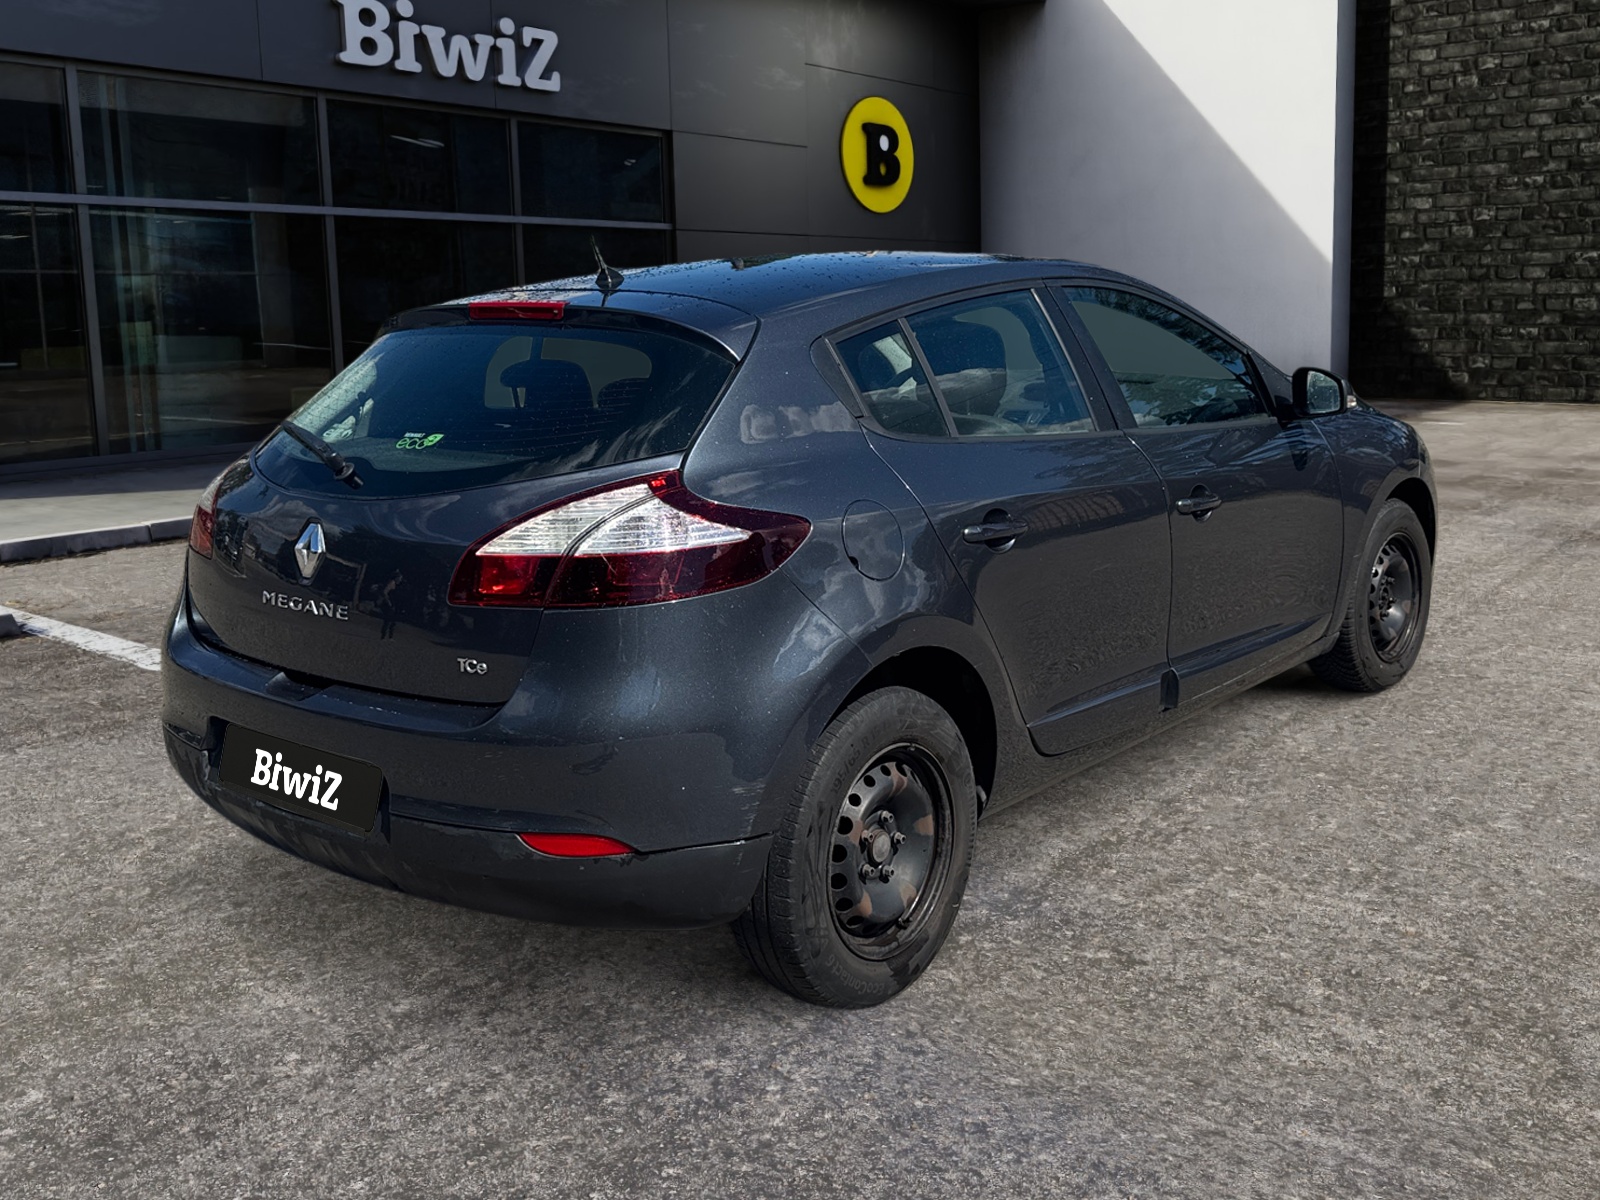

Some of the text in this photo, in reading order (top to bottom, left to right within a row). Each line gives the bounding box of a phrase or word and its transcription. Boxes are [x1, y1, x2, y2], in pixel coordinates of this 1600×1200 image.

[861, 122, 901, 188] B
[262, 590, 349, 620] MEGANE
[457, 658, 487, 675] TCe
